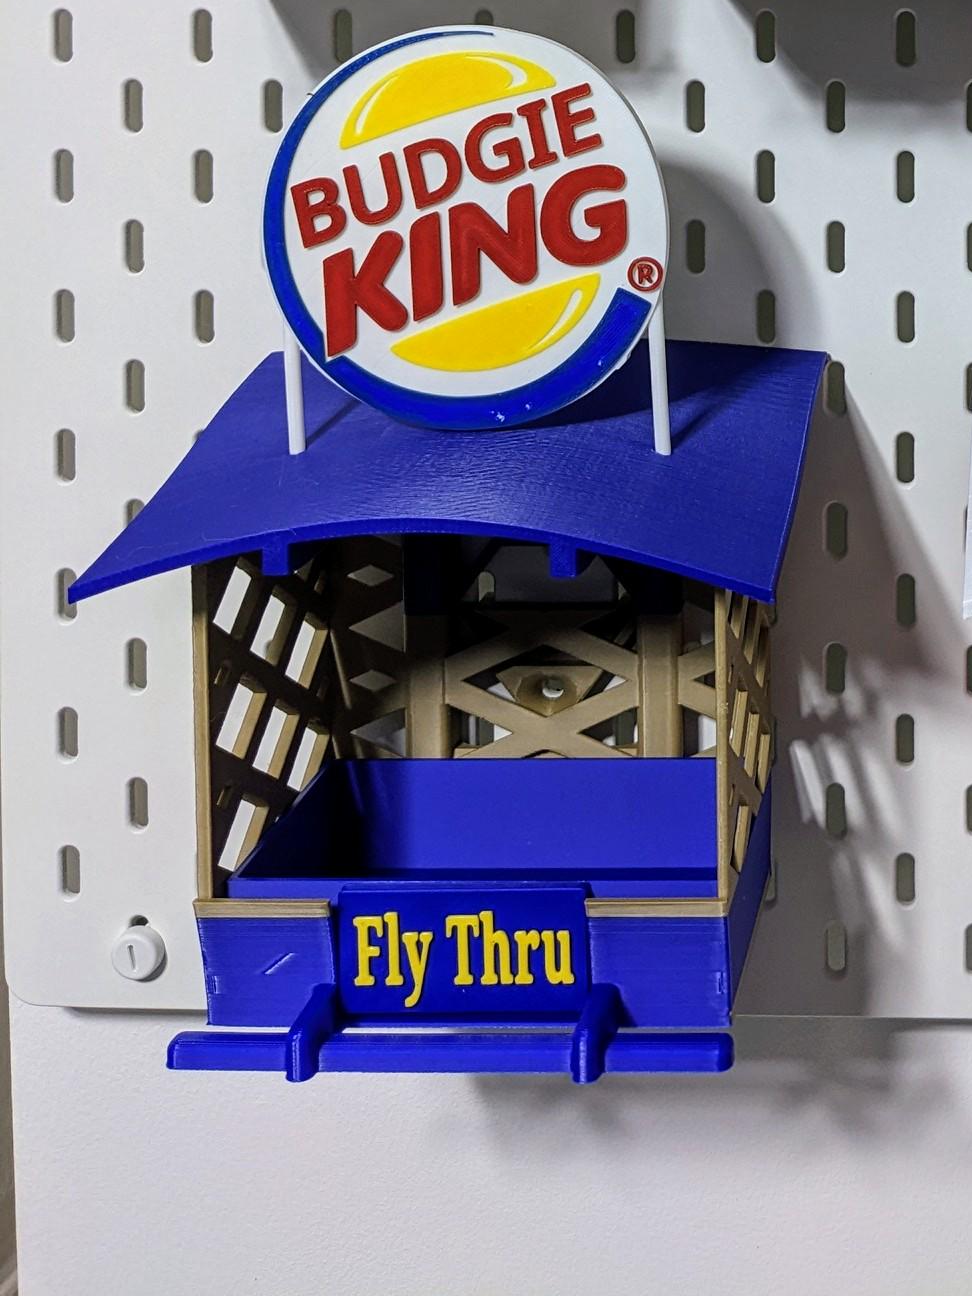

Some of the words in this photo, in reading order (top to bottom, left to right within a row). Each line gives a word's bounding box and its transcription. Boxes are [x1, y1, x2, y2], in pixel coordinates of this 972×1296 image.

[290, 82, 604, 251] BUDGIE
[321, 163, 629, 359] KING
[352, 911, 434, 1009] Fly
[445, 909, 576, 986] Thru
